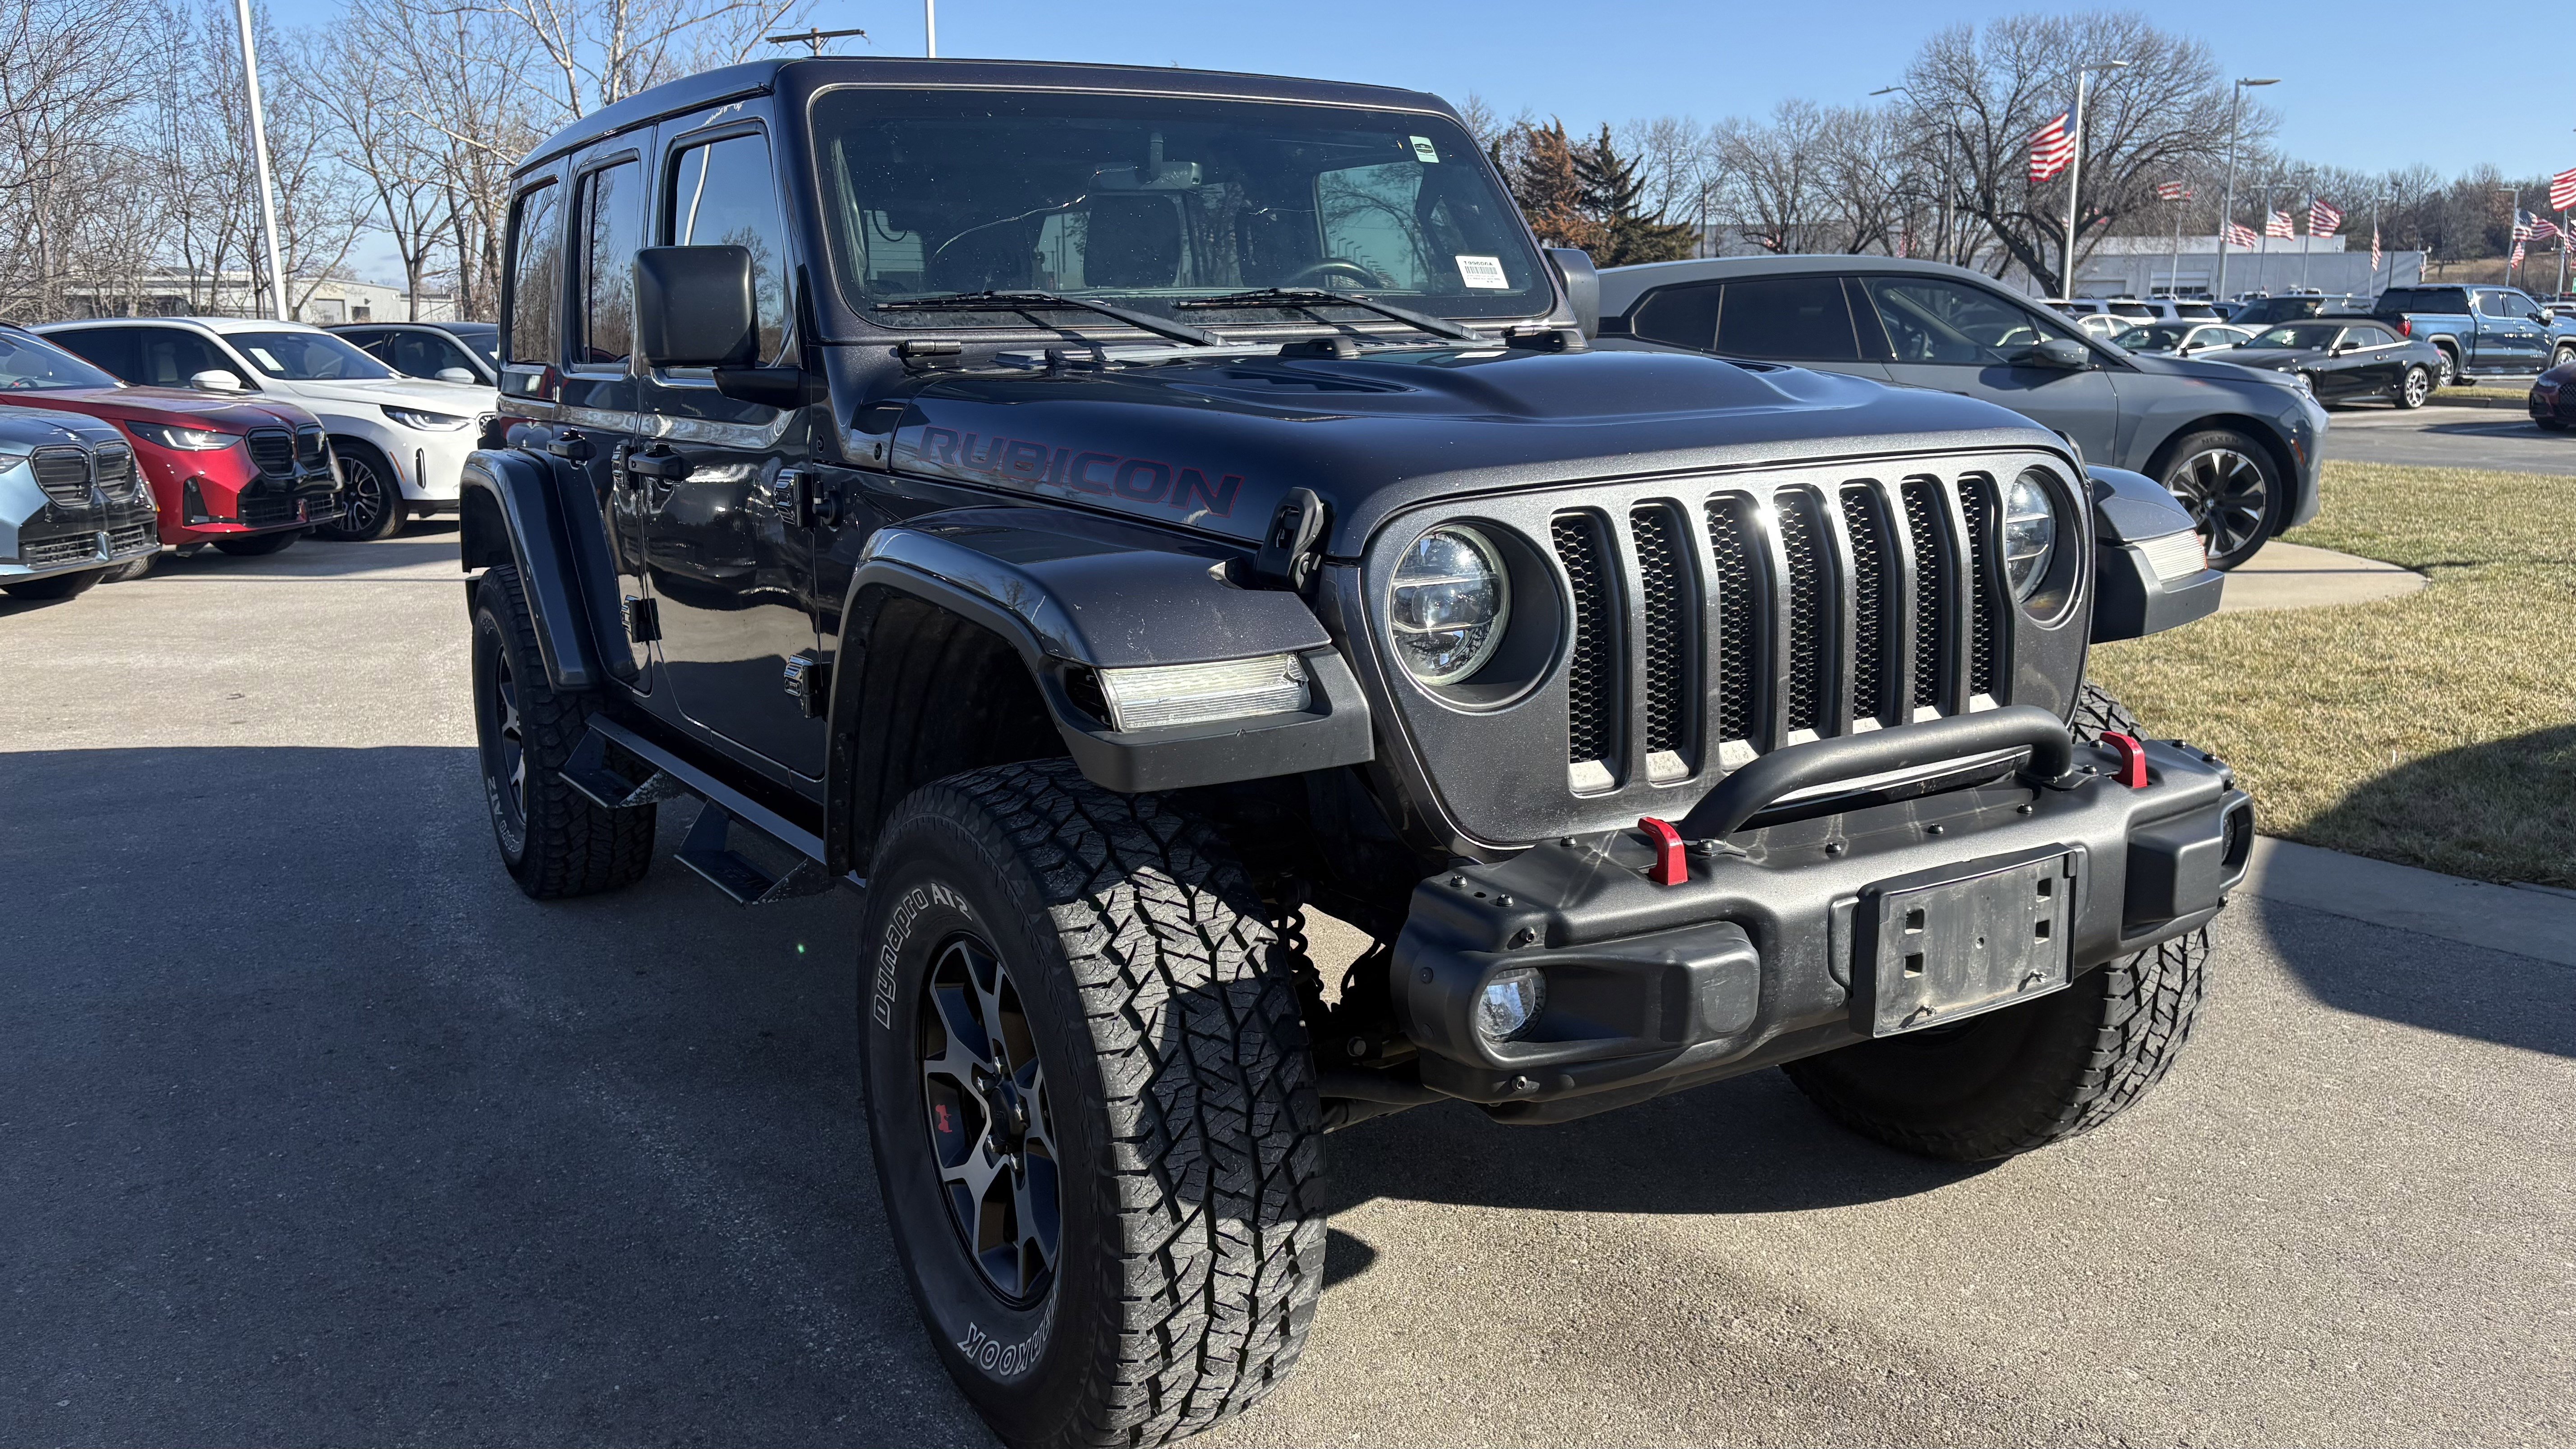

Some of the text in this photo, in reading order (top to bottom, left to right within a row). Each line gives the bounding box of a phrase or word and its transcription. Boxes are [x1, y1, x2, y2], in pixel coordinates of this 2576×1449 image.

[917, 426, 1245, 518] RUBICON
[2201, 436, 2238, 444] NEXEN
[874, 883, 973, 1030] Dynapro AT2
